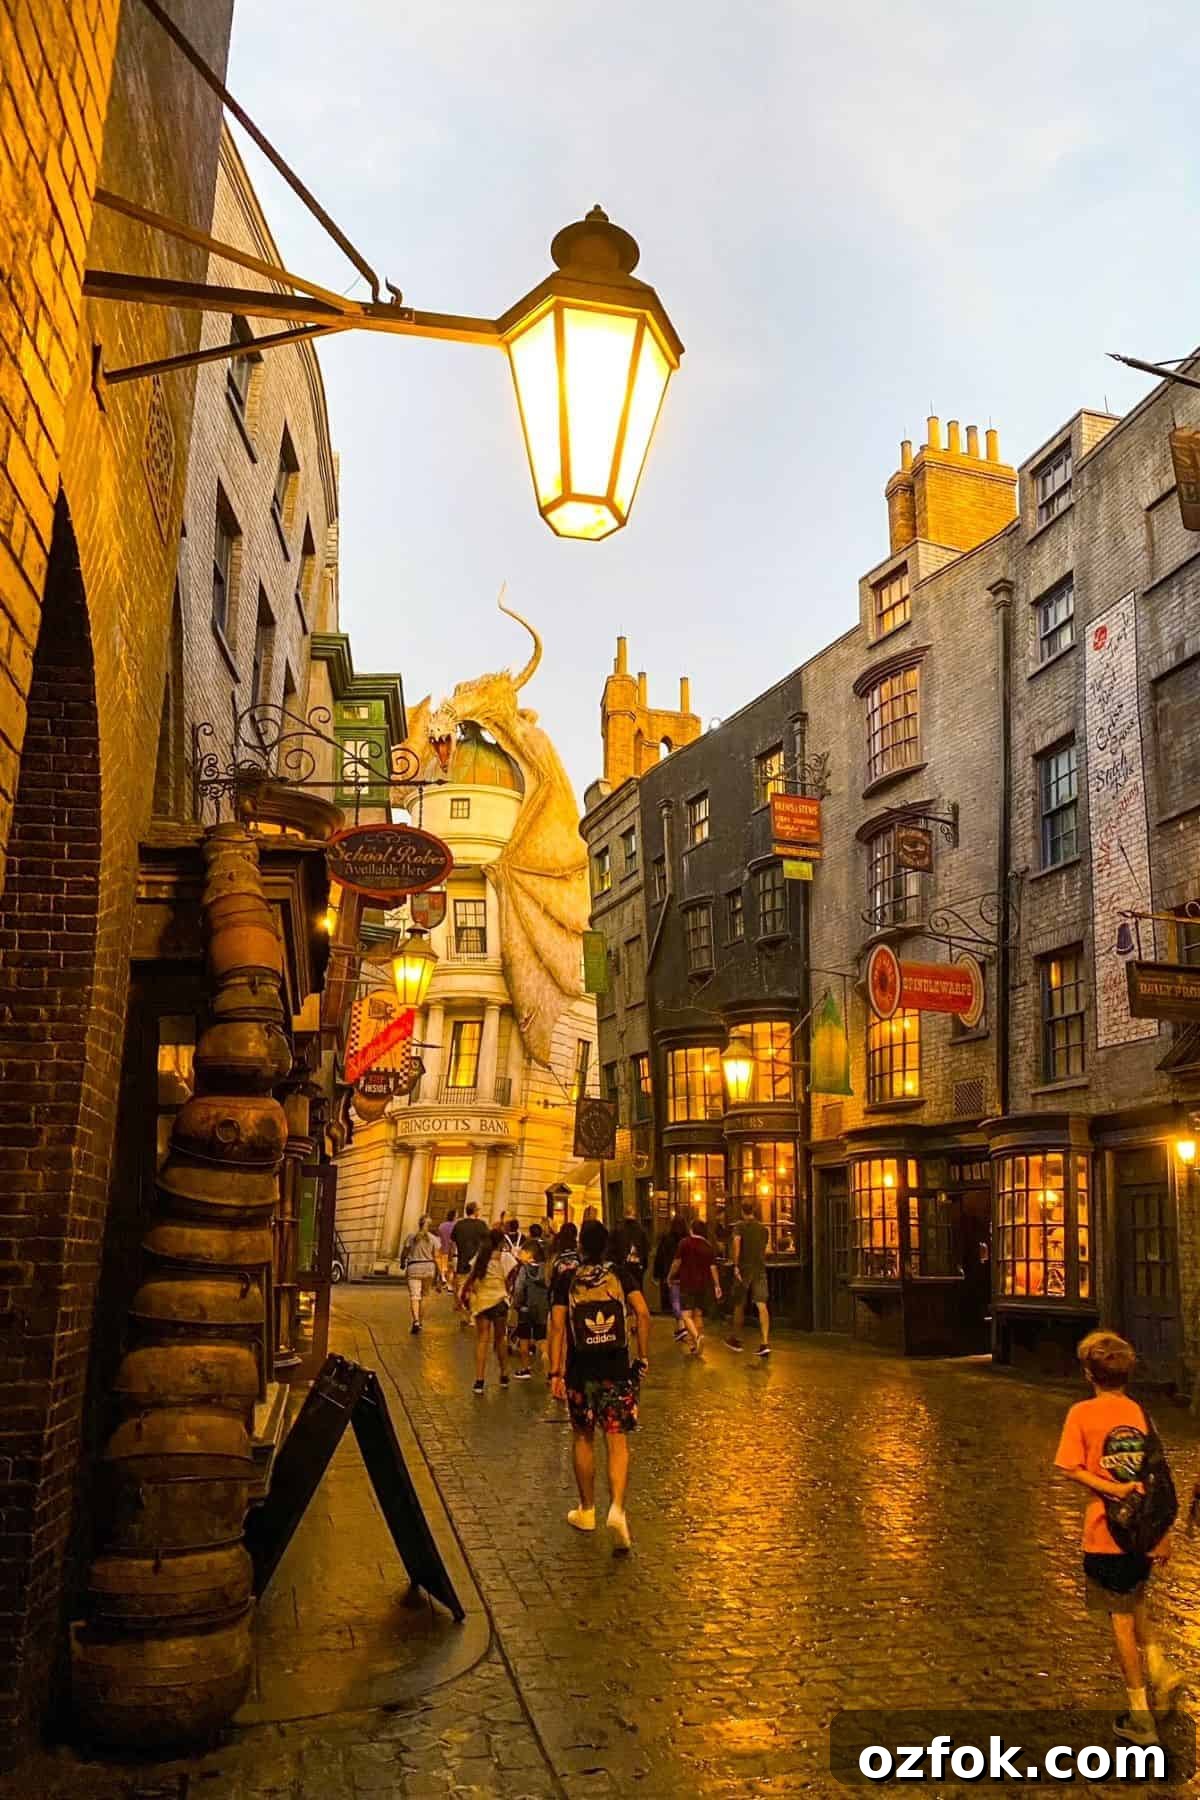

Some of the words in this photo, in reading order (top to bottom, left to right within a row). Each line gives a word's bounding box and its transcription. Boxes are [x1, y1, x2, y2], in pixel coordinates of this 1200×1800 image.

[392, 845, 446, 865] Robes
[345, 862, 398, 876] Available
[586, 1334, 616, 1345] adidas
